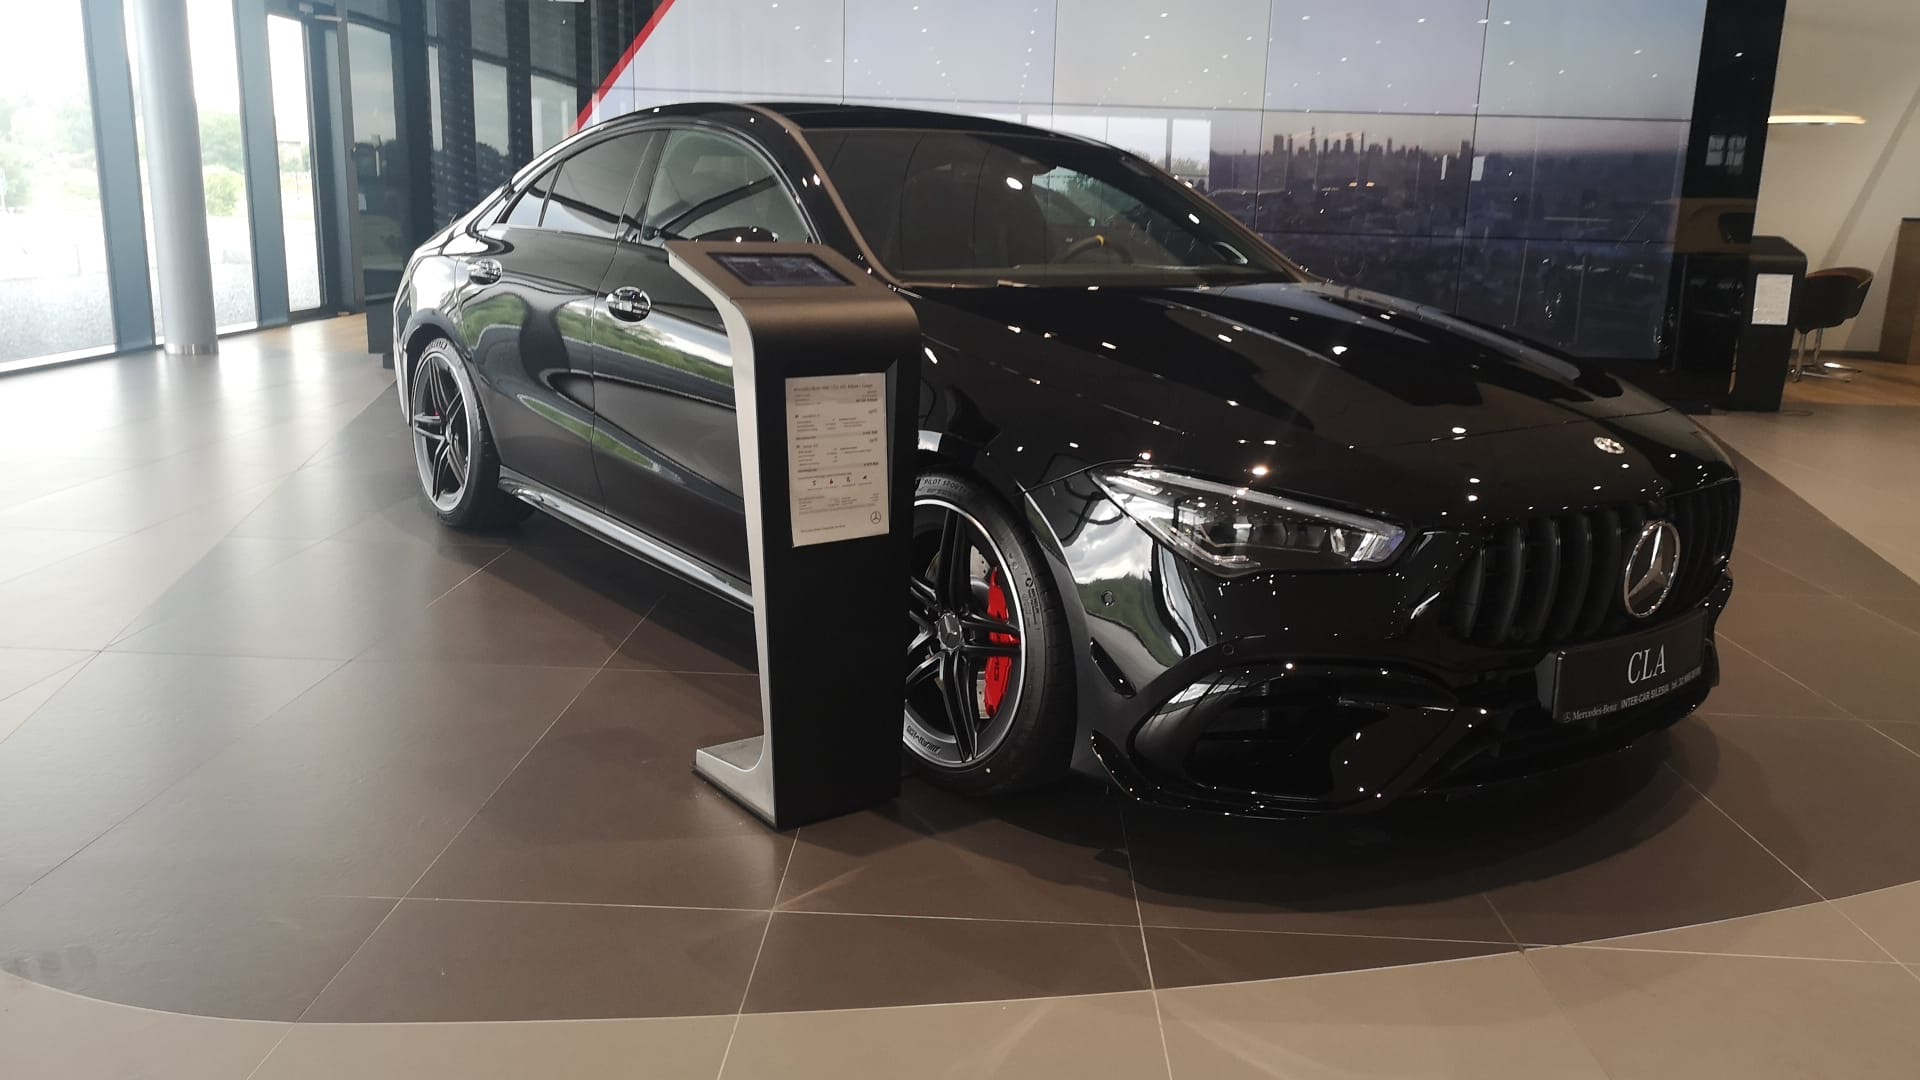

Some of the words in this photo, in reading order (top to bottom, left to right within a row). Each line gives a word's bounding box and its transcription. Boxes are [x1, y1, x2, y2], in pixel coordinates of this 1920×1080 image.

[1627, 643, 1666, 684] CLA
[1572, 703, 1618, 721] Mercedes-Benz
[1621, 691, 1650, 709] INTER-CAR
[1650, 684, 1669, 699] SILESIA
